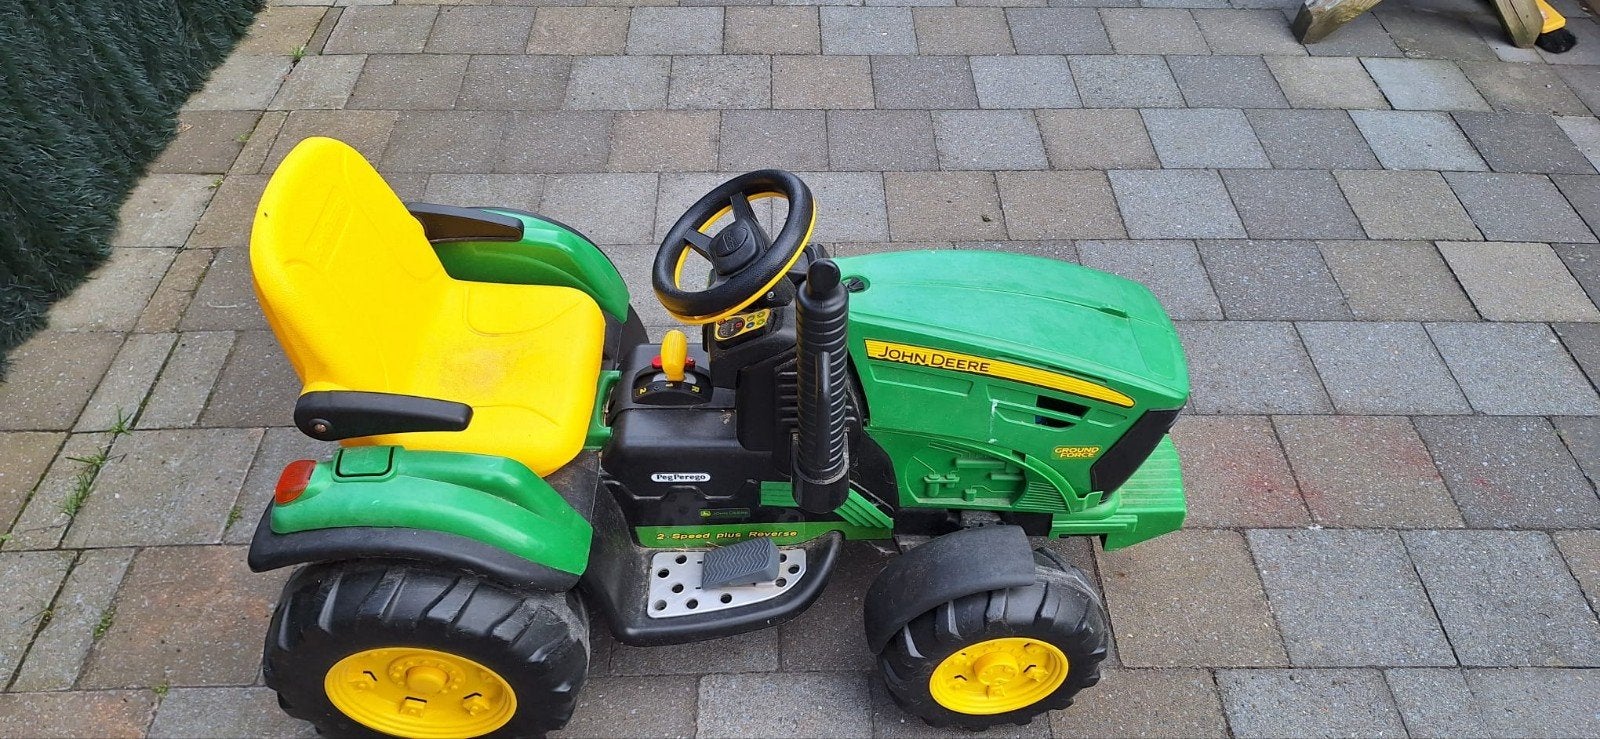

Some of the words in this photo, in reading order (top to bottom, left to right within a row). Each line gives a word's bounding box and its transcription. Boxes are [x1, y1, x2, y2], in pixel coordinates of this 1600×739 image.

[878, 346, 927, 364] JOHN
[930, 353, 991, 373] DEERE
[1054, 446, 1100, 454] GROUND
